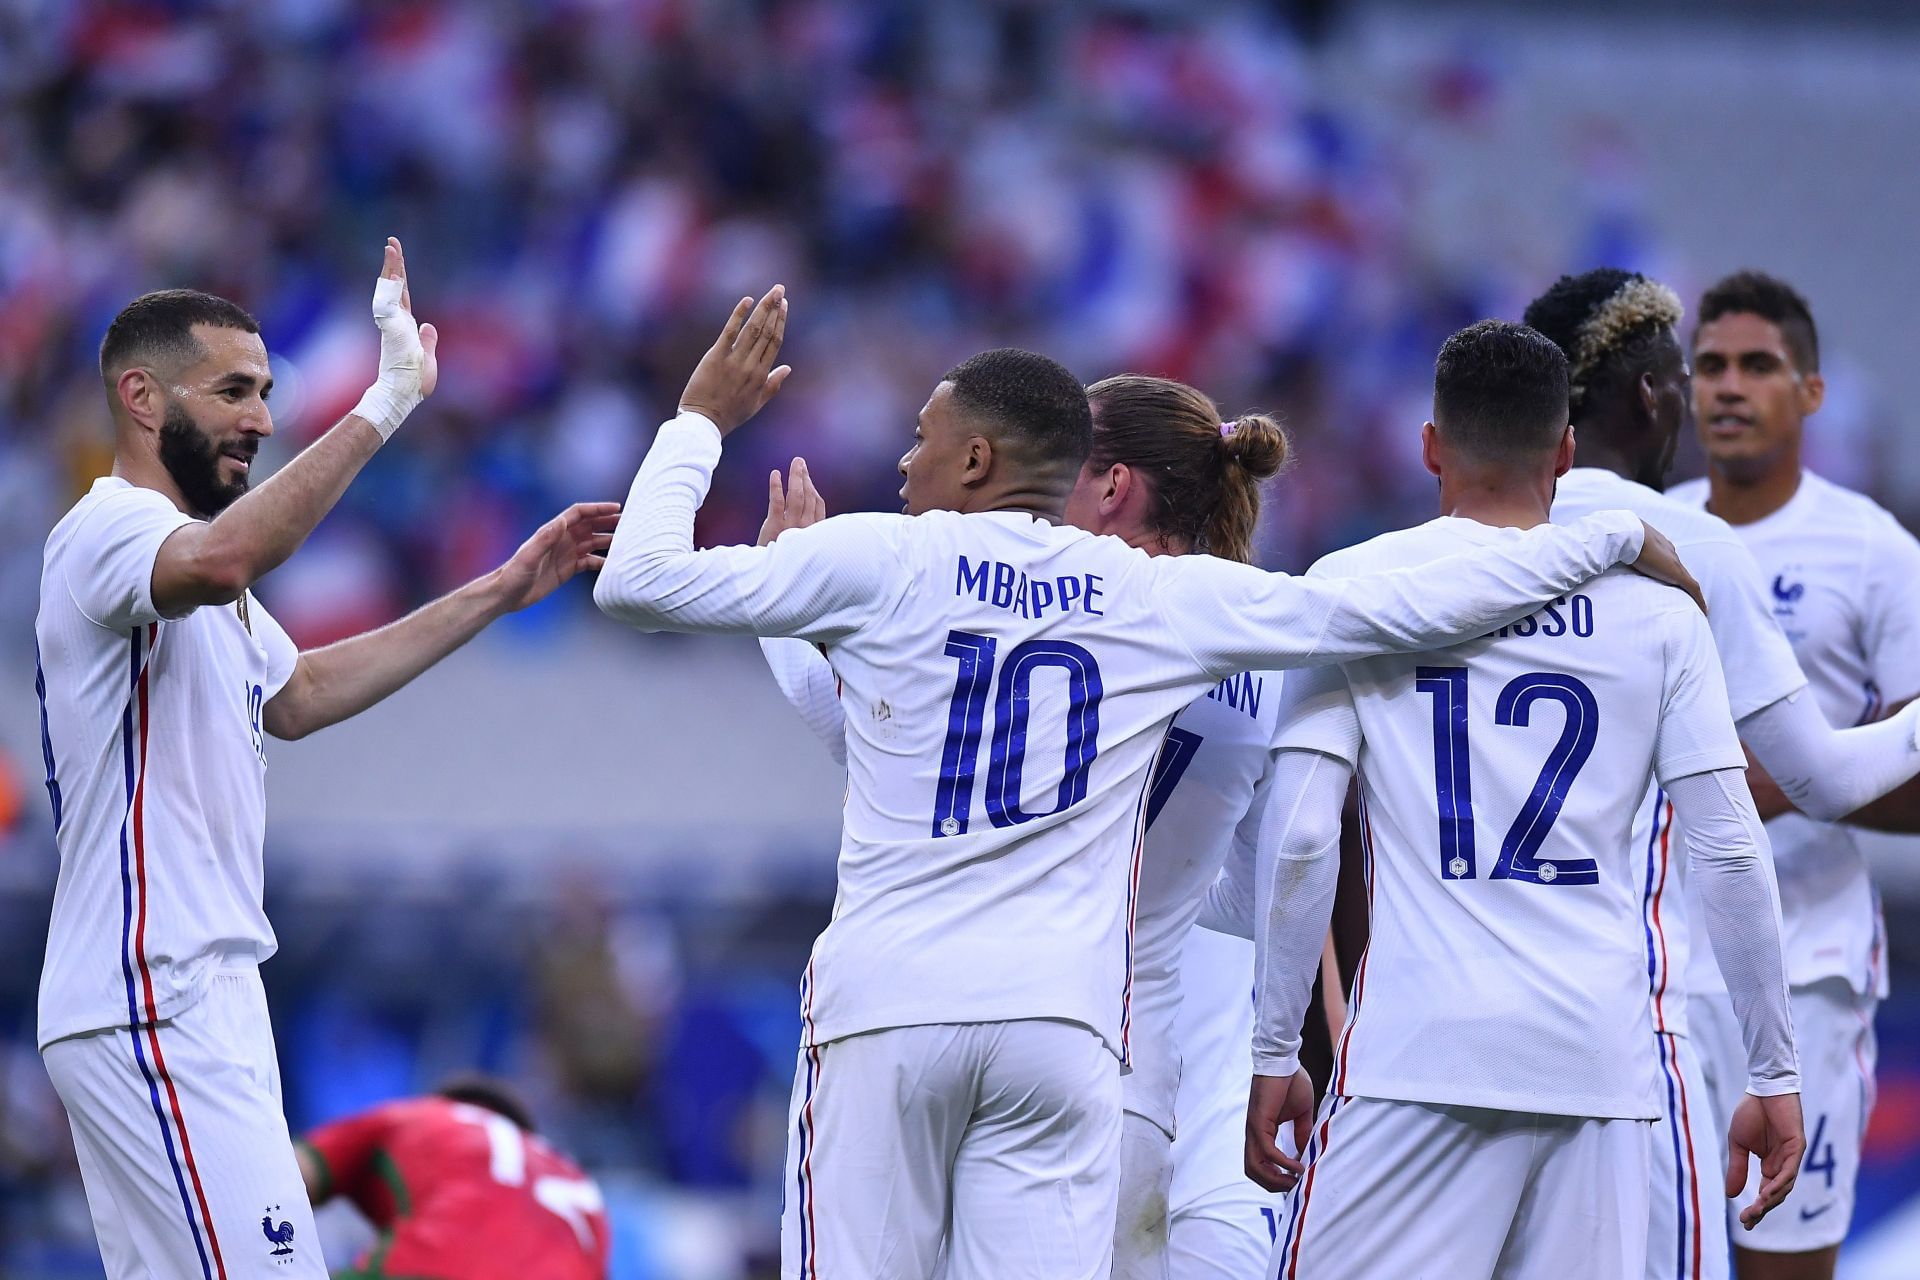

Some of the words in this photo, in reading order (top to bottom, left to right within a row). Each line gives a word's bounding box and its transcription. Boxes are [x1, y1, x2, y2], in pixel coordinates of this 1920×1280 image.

[956, 554, 1104, 620] MBAPPE
[931, 629, 1103, 838] 10
[1415, 666, 1600, 886] 12
[1803, 1114, 1837, 1188] 4
